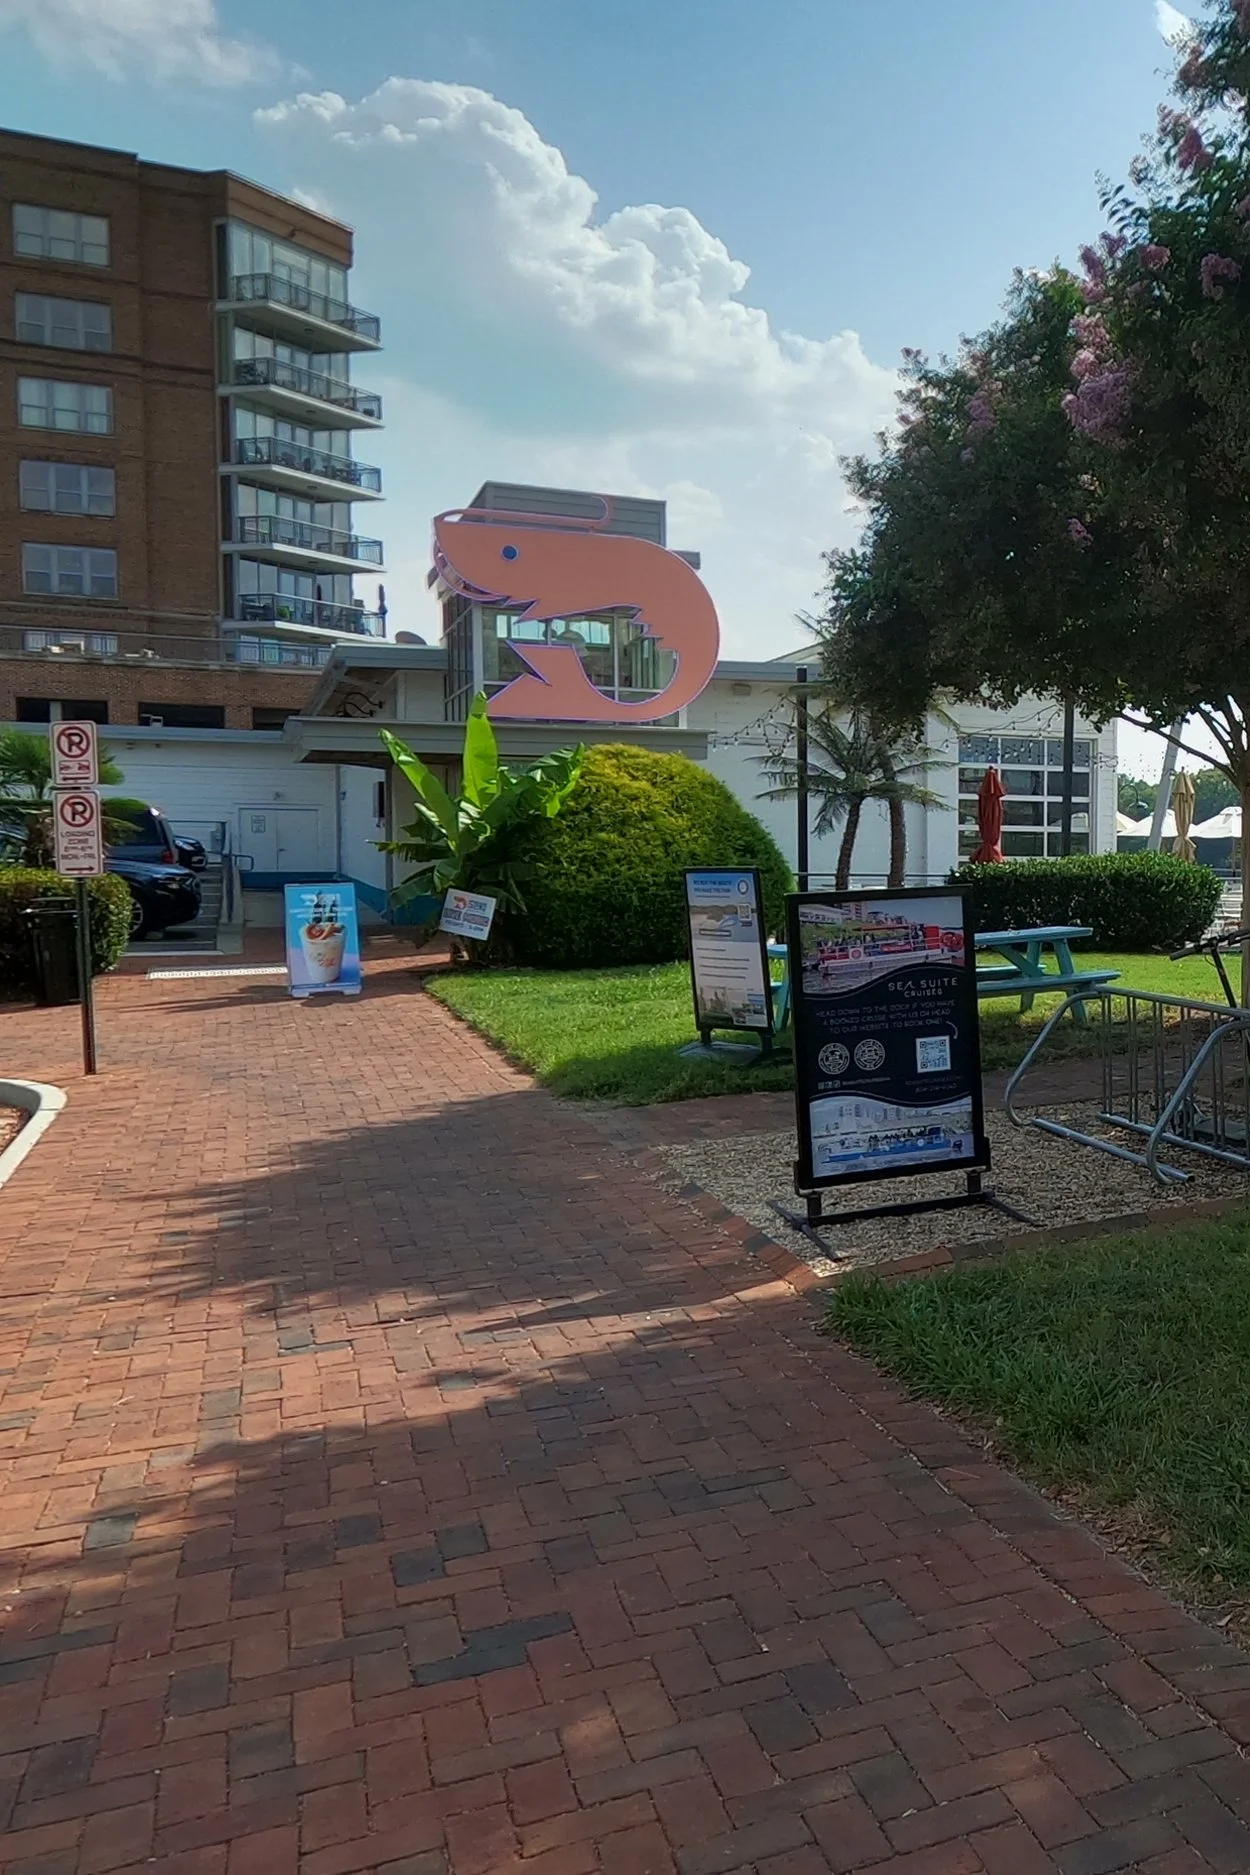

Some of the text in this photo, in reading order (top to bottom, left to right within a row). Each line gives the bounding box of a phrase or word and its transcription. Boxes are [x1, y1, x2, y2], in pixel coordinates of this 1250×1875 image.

[60, 830, 95, 838] LOADING
[67, 837, 89, 845] ZONE
[888, 977, 958, 991] SEA SUITE
[904, 988, 943, 998] CRUISES
[920, 1001, 935, 1009] YOU
